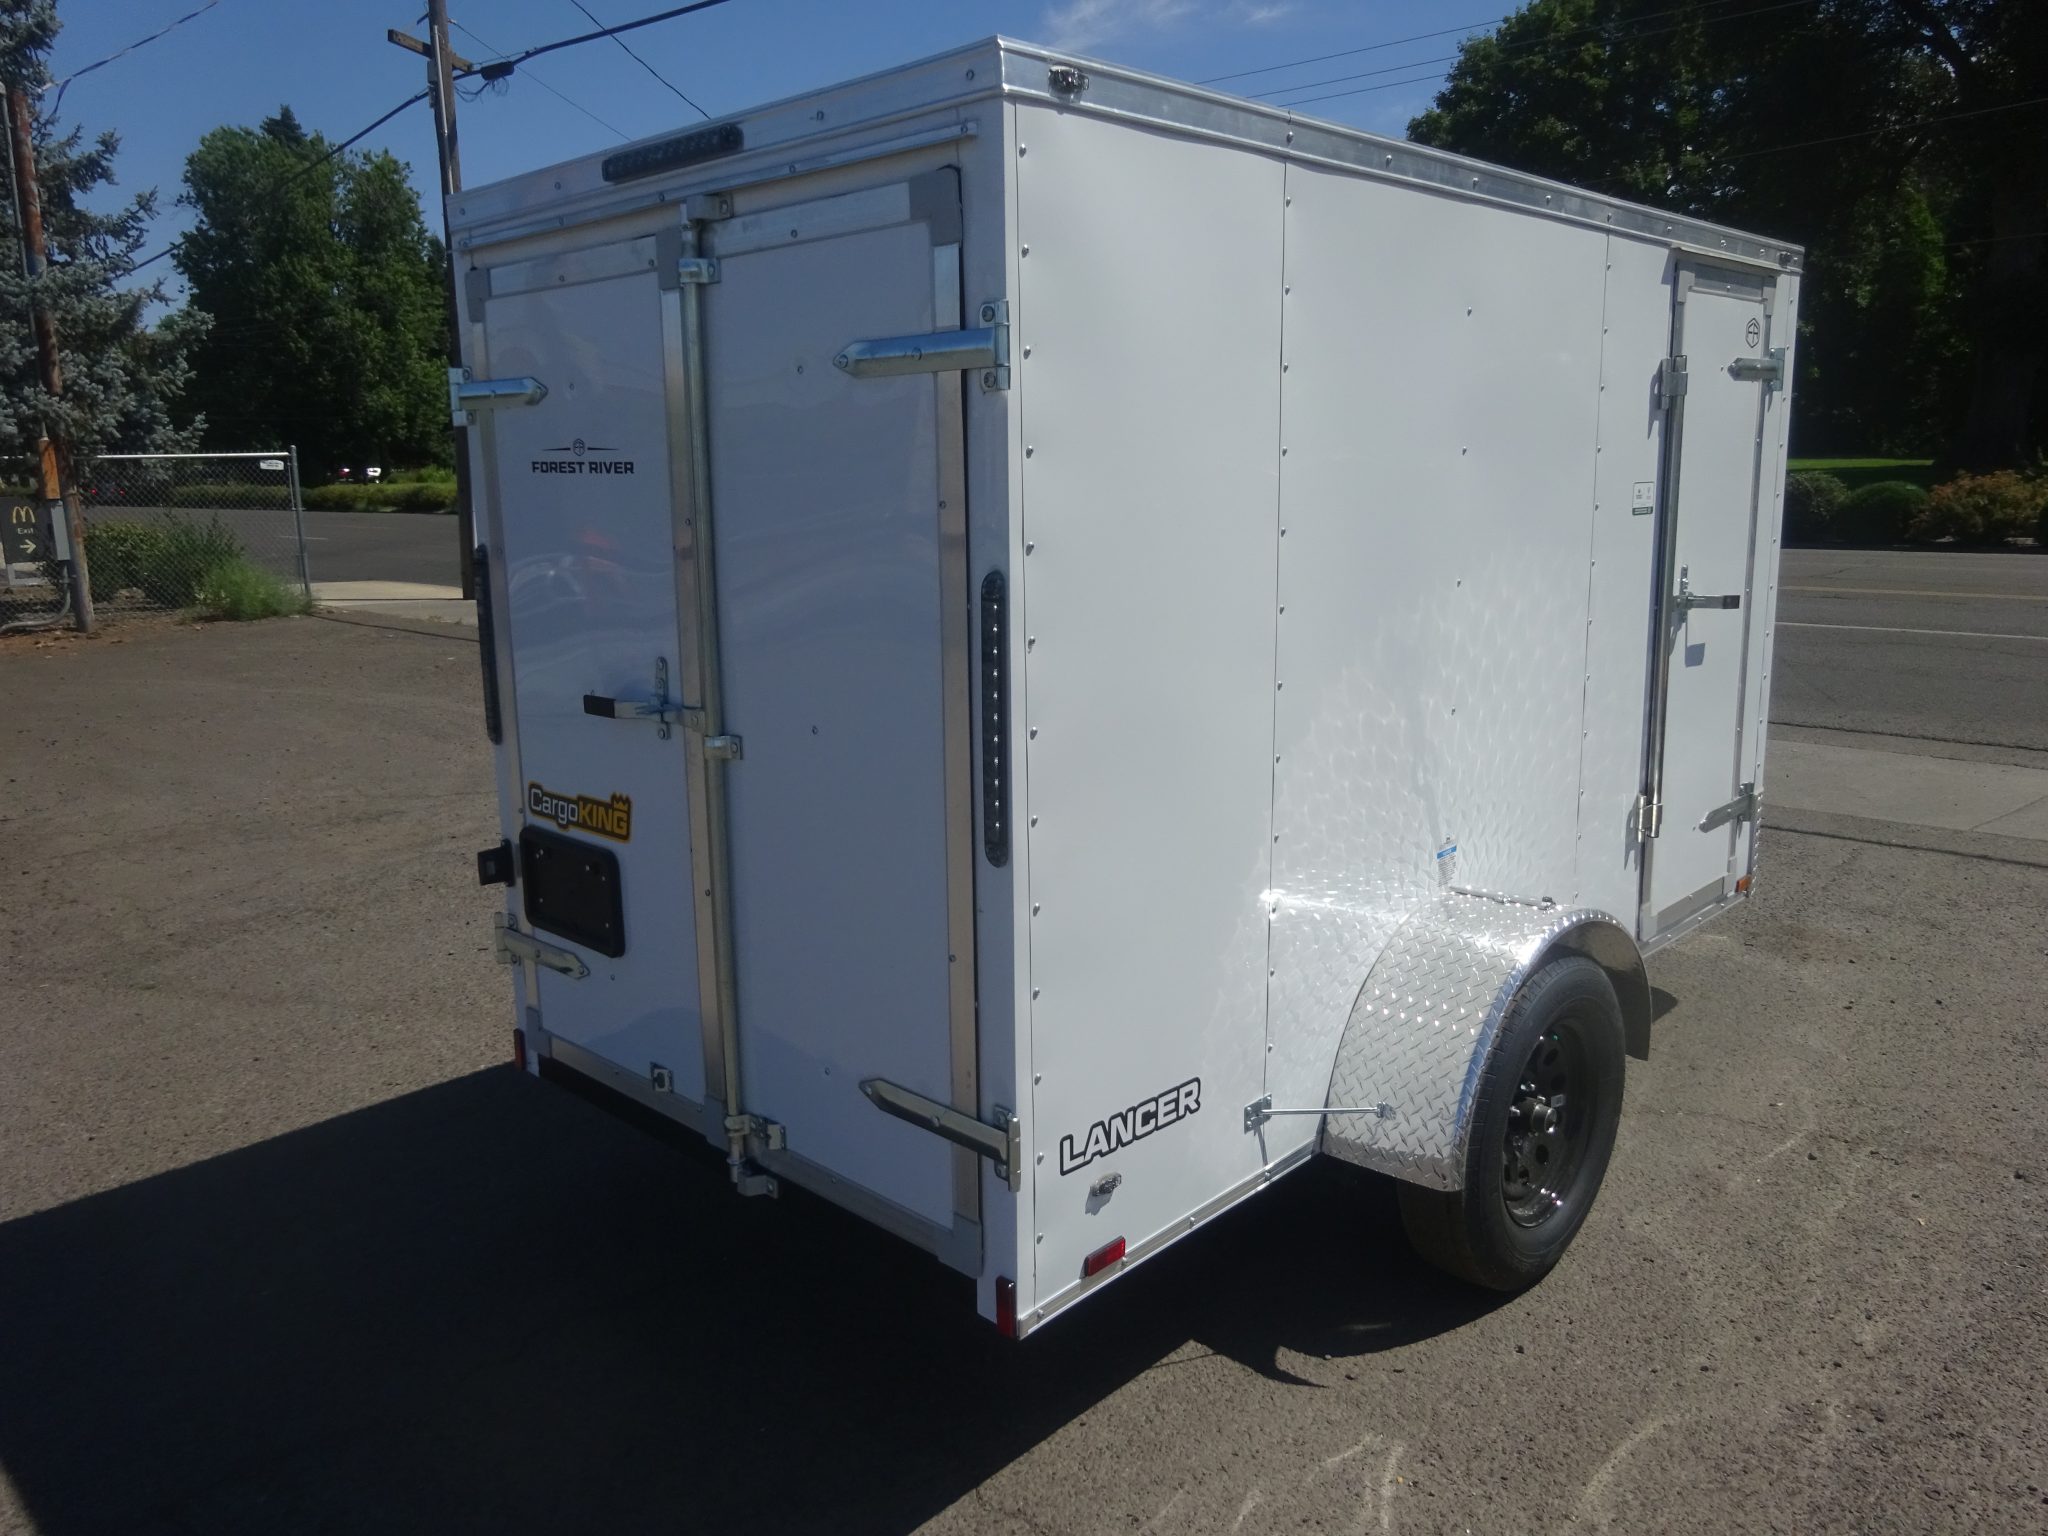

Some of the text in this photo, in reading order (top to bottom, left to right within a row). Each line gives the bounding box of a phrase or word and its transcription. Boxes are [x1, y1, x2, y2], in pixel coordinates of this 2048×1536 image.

[531, 461, 635, 475] FOREST RIVER
[531, 788, 628, 835] CargoKING
[1060, 1077, 1201, 1176] LANCER
